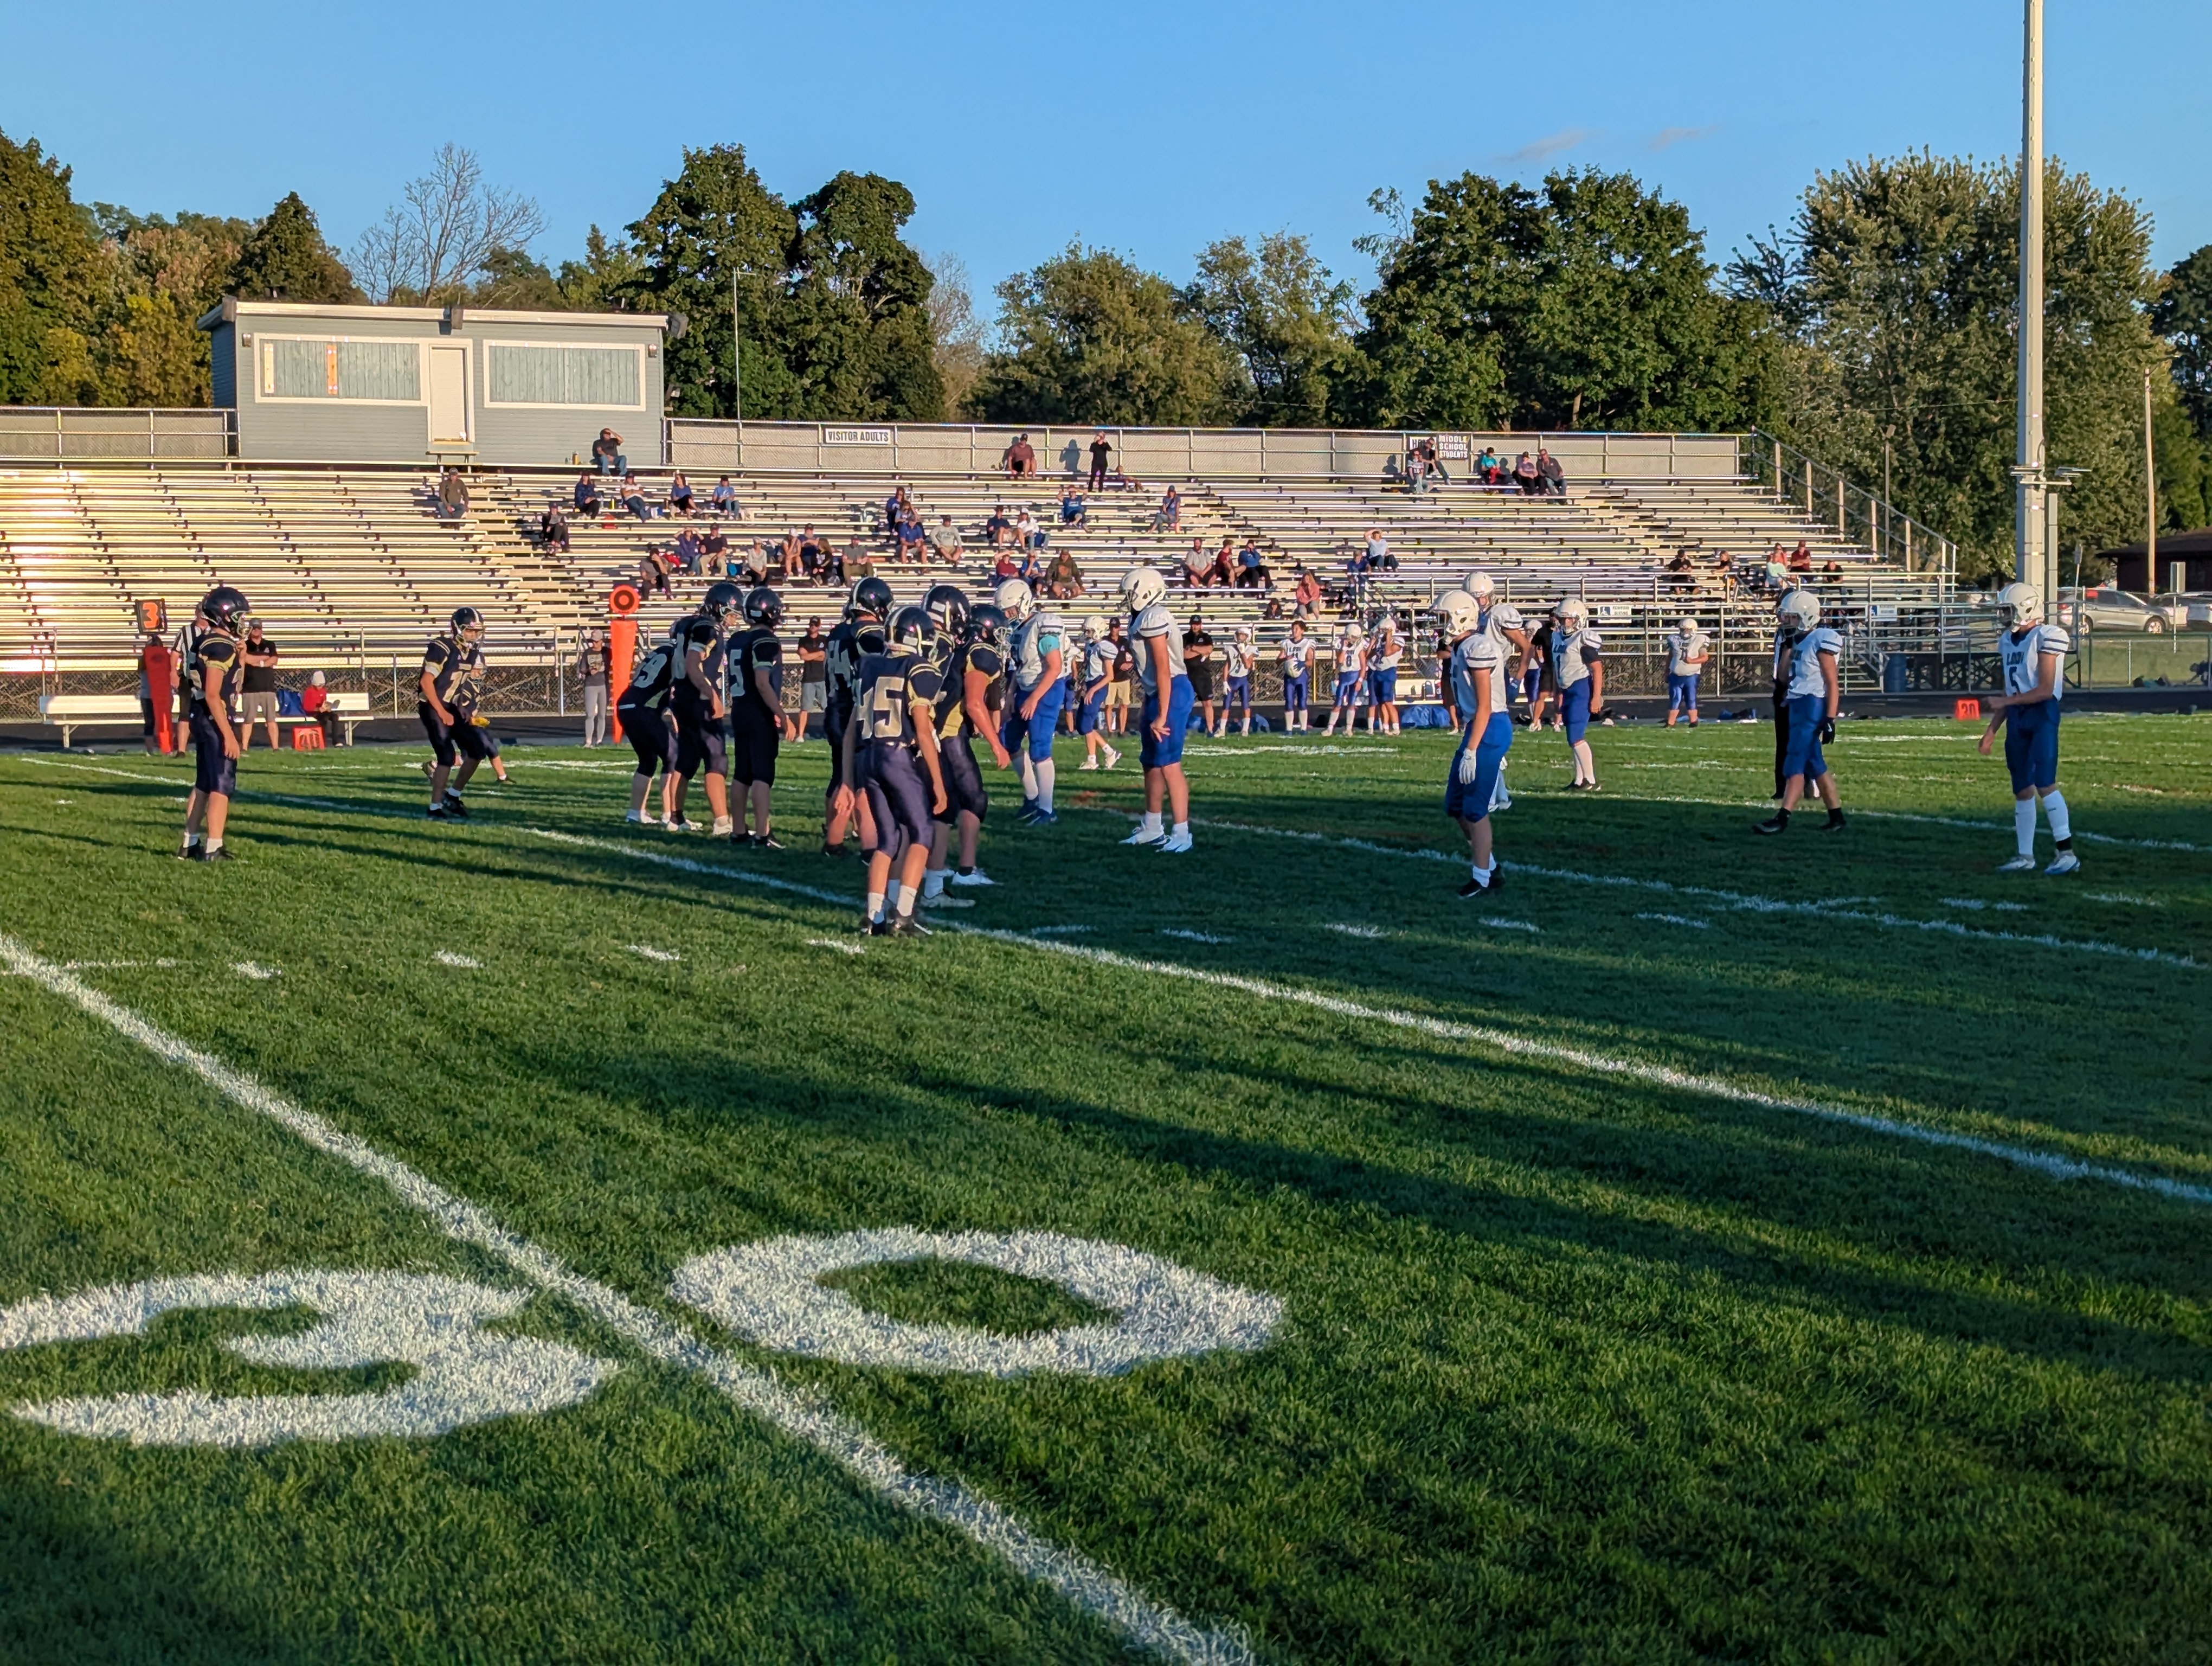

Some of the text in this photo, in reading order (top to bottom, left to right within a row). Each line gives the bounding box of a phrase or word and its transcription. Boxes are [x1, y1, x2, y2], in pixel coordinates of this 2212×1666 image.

[828, 431, 888, 441] VISITOR ADULTS
[143, 602, 158, 628] 3
[852, 676, 905, 739] 45
